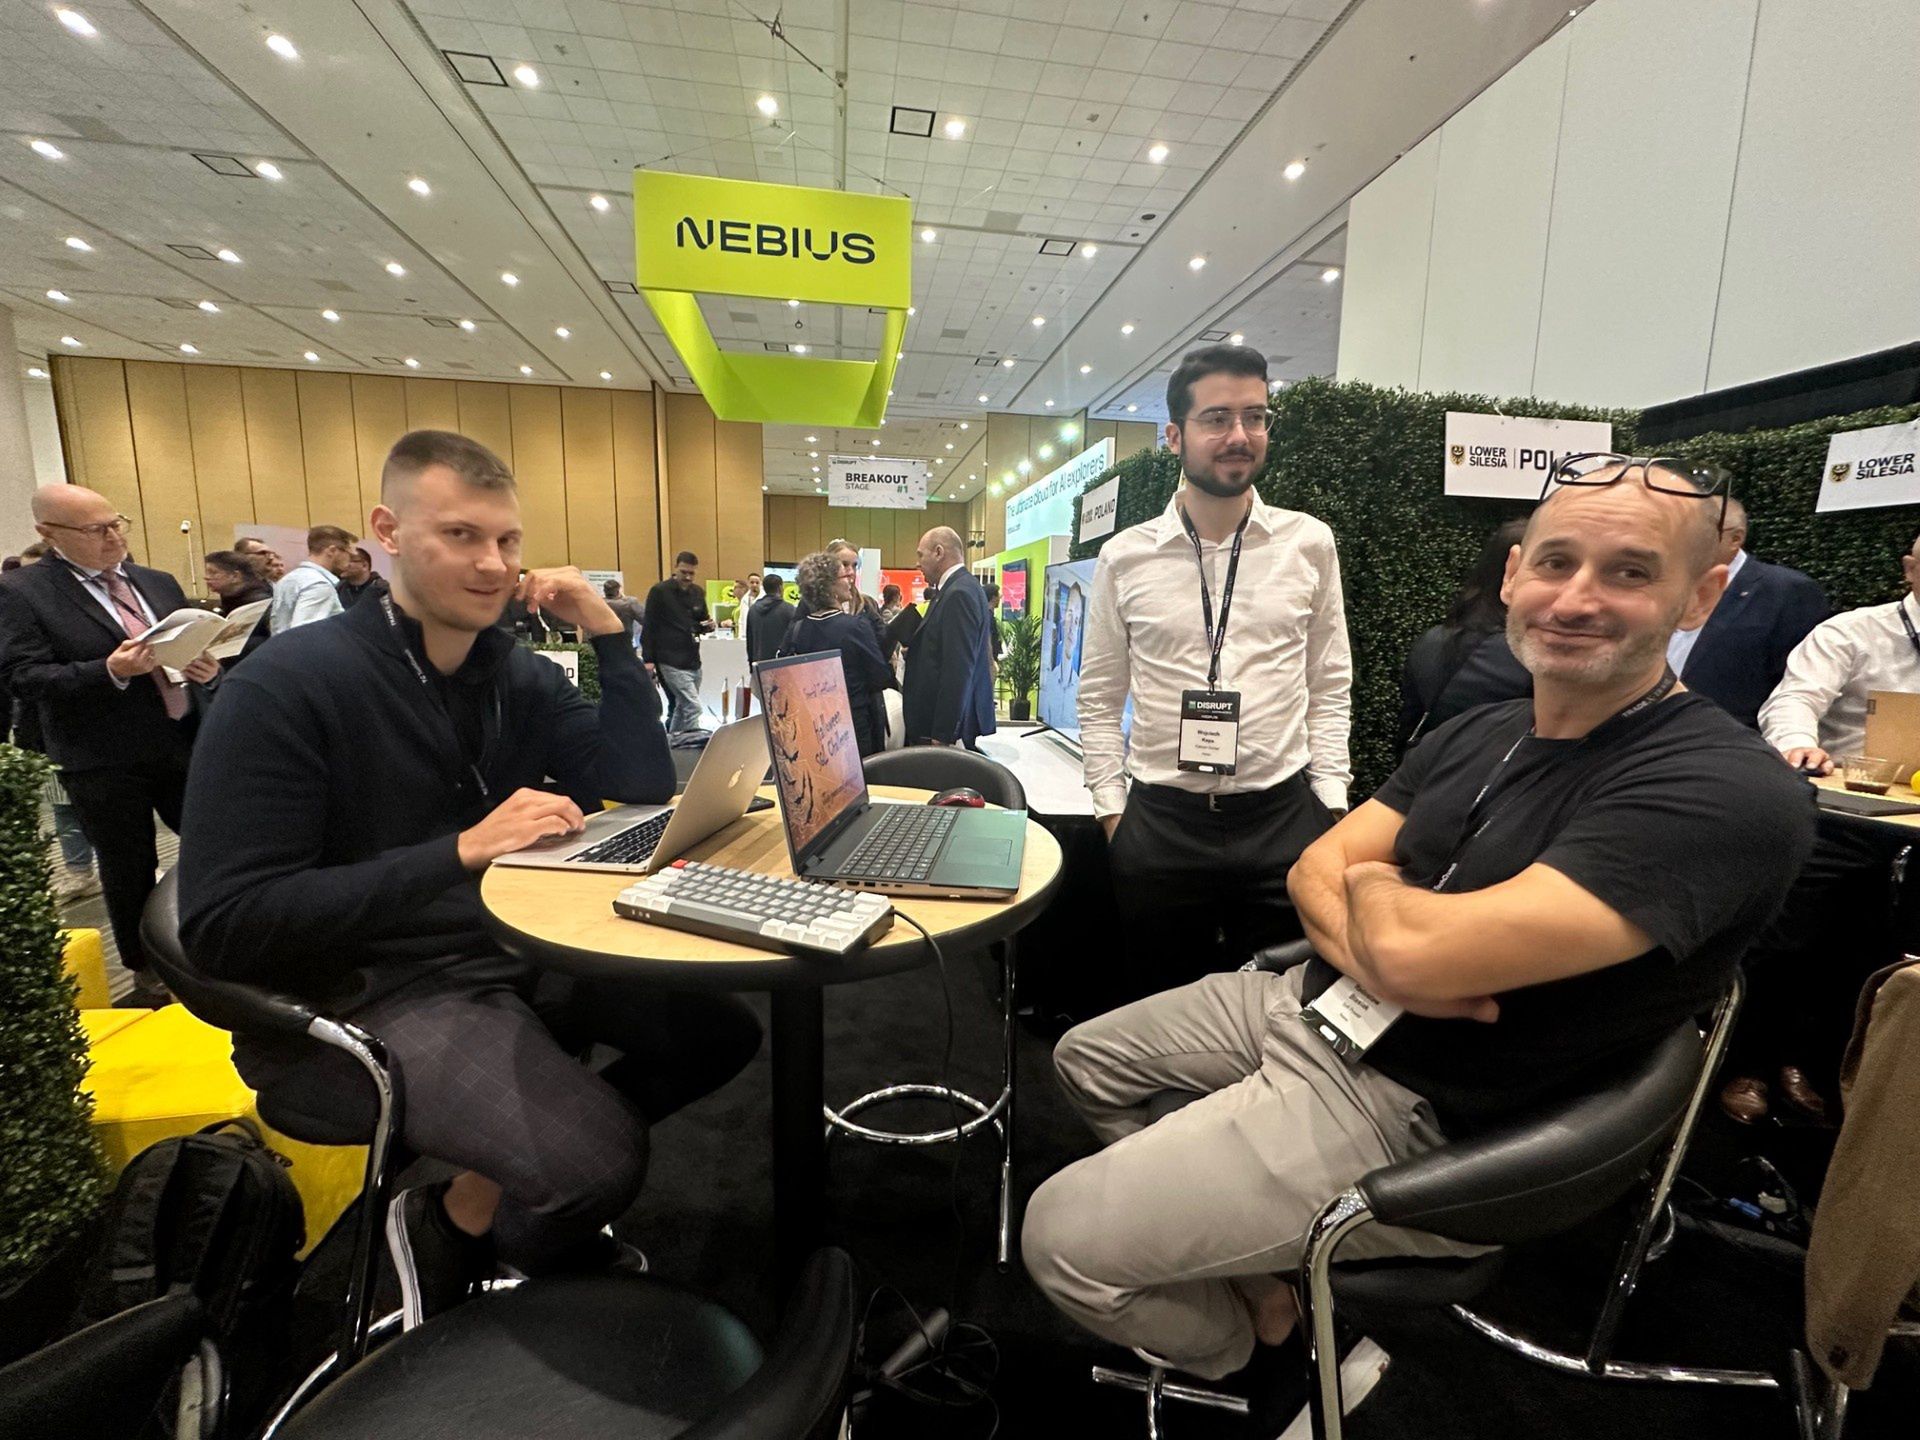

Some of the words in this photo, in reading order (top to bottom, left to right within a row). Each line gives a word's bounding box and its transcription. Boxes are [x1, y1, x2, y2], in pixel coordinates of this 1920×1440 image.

[676, 216, 876, 265] NEBIUS
[1469, 445, 1506, 458] LOWER
[1469, 457, 1508, 469] SILESIA
[1858, 453, 1915, 469] LOWER
[1067, 453, 1105, 488] explorers
[1856, 464, 1915, 480] SILESIA
[845, 472, 908, 484] BREAKOUT
[897, 485, 908, 493] #1
[1094, 498, 1116, 520] POLAND
[1196, 701, 1233, 711] DISRUPT
